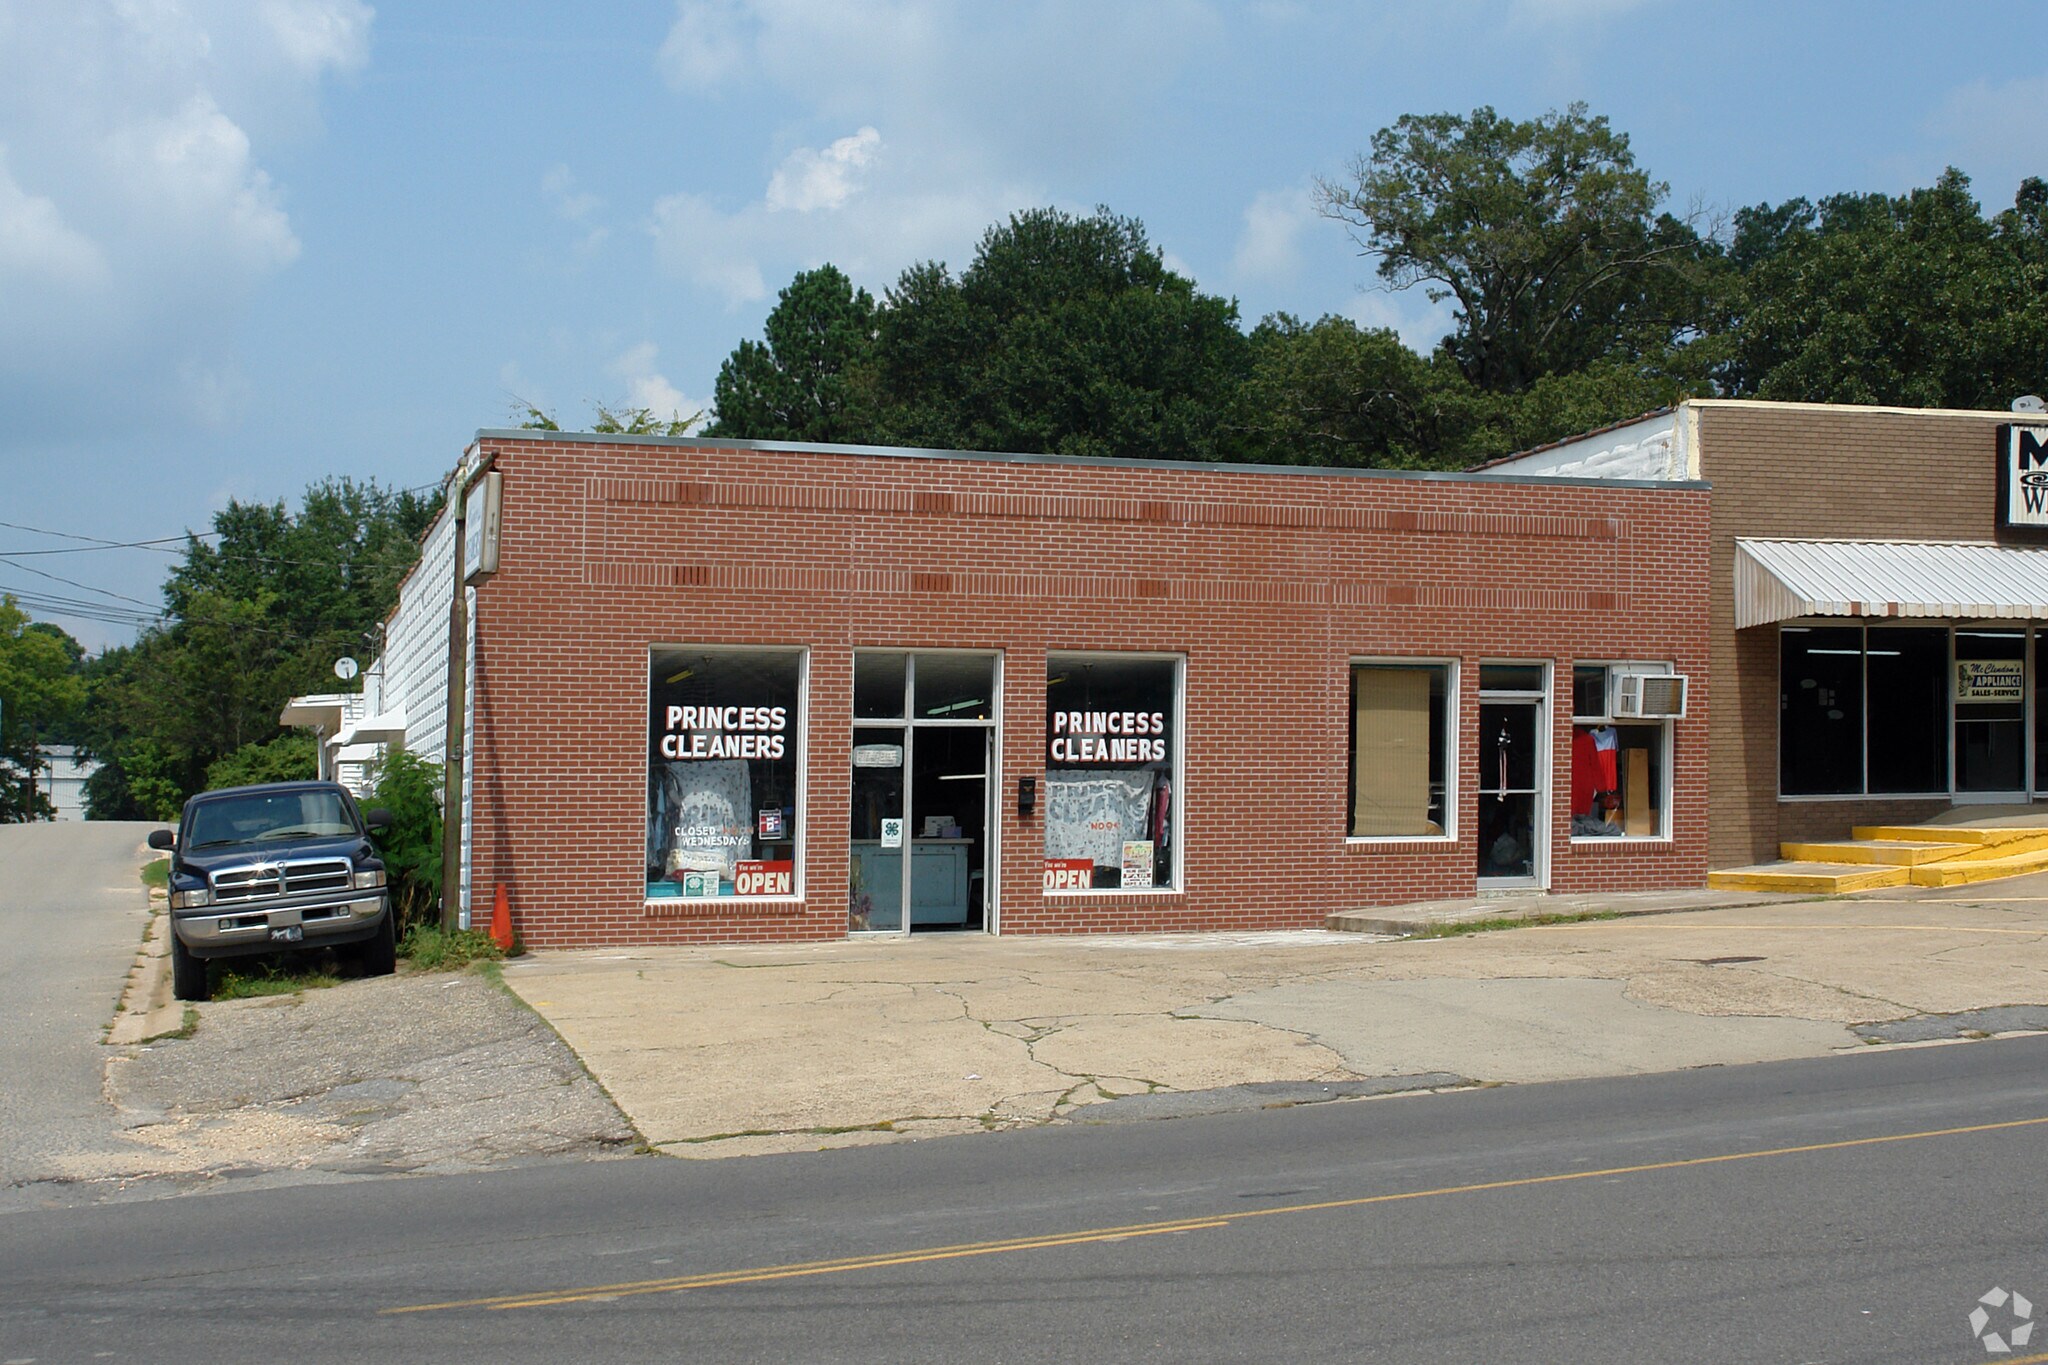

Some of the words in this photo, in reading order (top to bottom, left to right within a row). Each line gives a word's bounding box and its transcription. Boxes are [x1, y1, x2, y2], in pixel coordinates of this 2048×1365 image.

[1975, 676, 2021, 687] APPLIANCE
[666, 705, 787, 731] PRINCESS
[1053, 711, 1164, 735] PRINCESS
[661, 734, 785, 760] CLEANERS
[1050, 738, 1166, 762] CLEANERS
[674, 826, 716, 836] CLOSED
[736, 872, 790, 894] OPEN
[1042, 869, 1091, 889] OPEN
